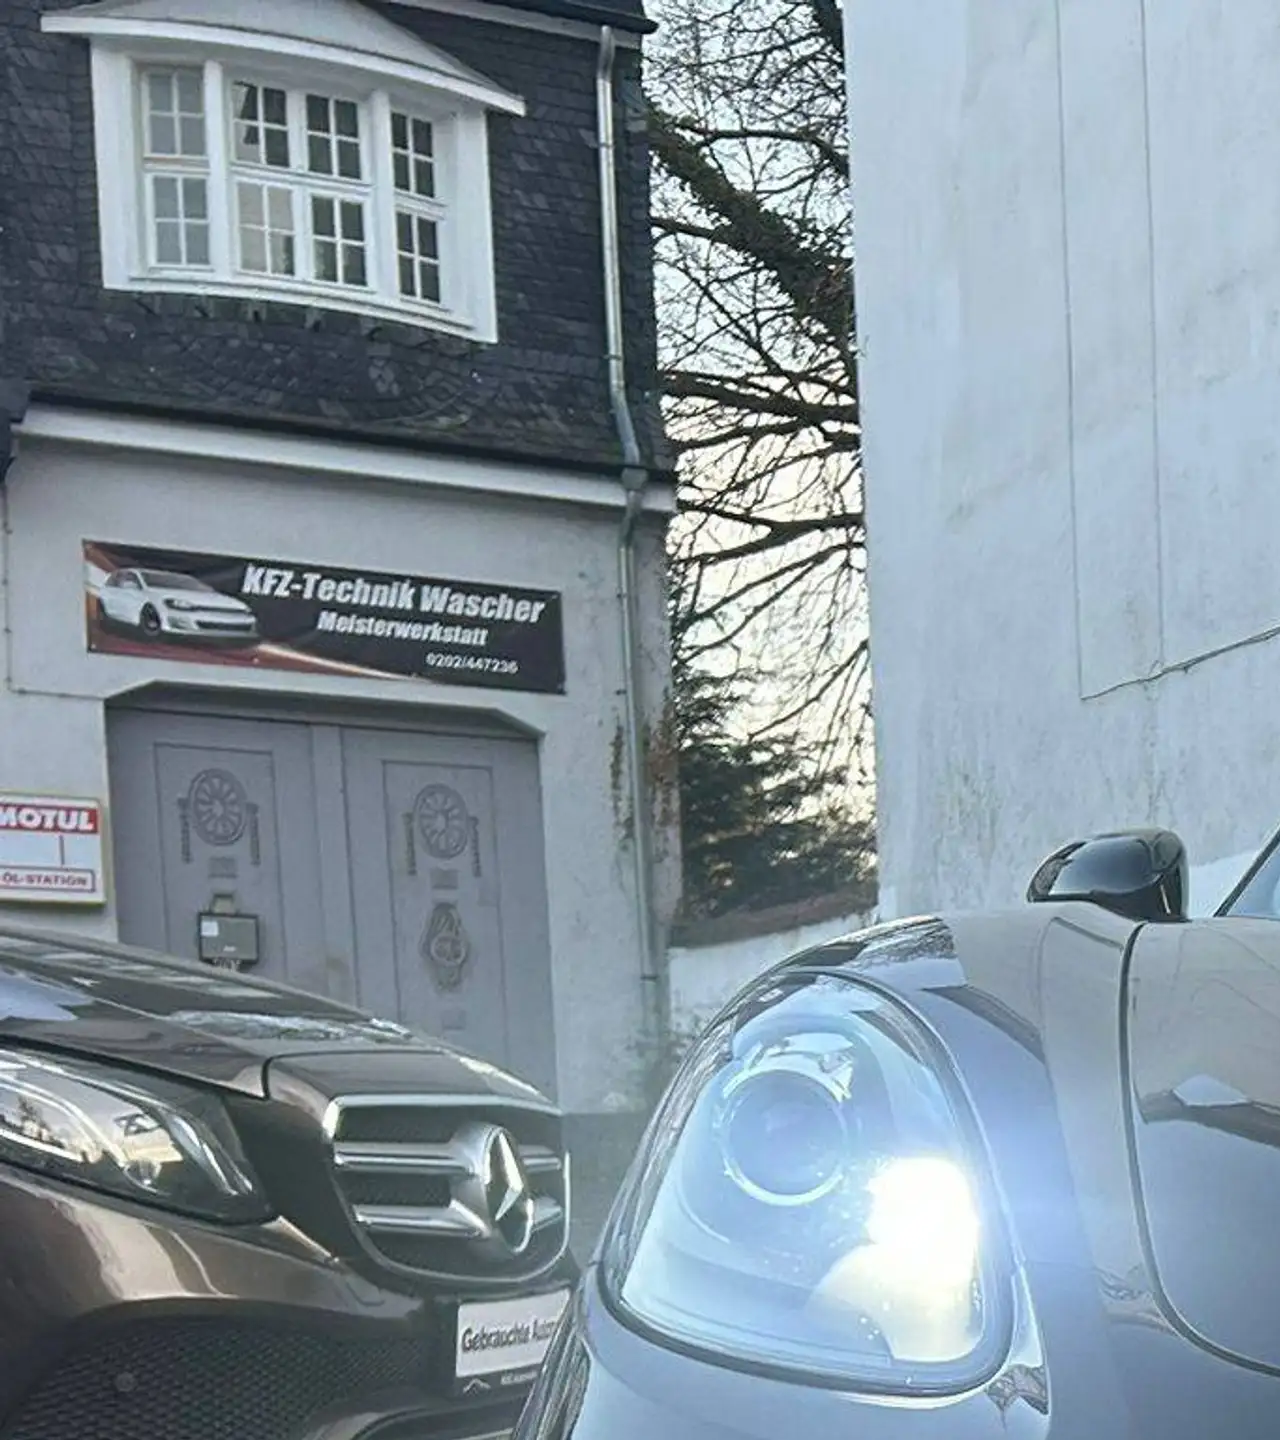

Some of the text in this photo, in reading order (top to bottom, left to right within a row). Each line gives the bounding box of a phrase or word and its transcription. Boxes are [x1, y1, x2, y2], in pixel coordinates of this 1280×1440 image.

[241, 563, 546, 624] KFZ-Technik Wascher
[315, 608, 489, 647] Meisterwerkstatt
[0, 805, 95, 830] MOTUL
